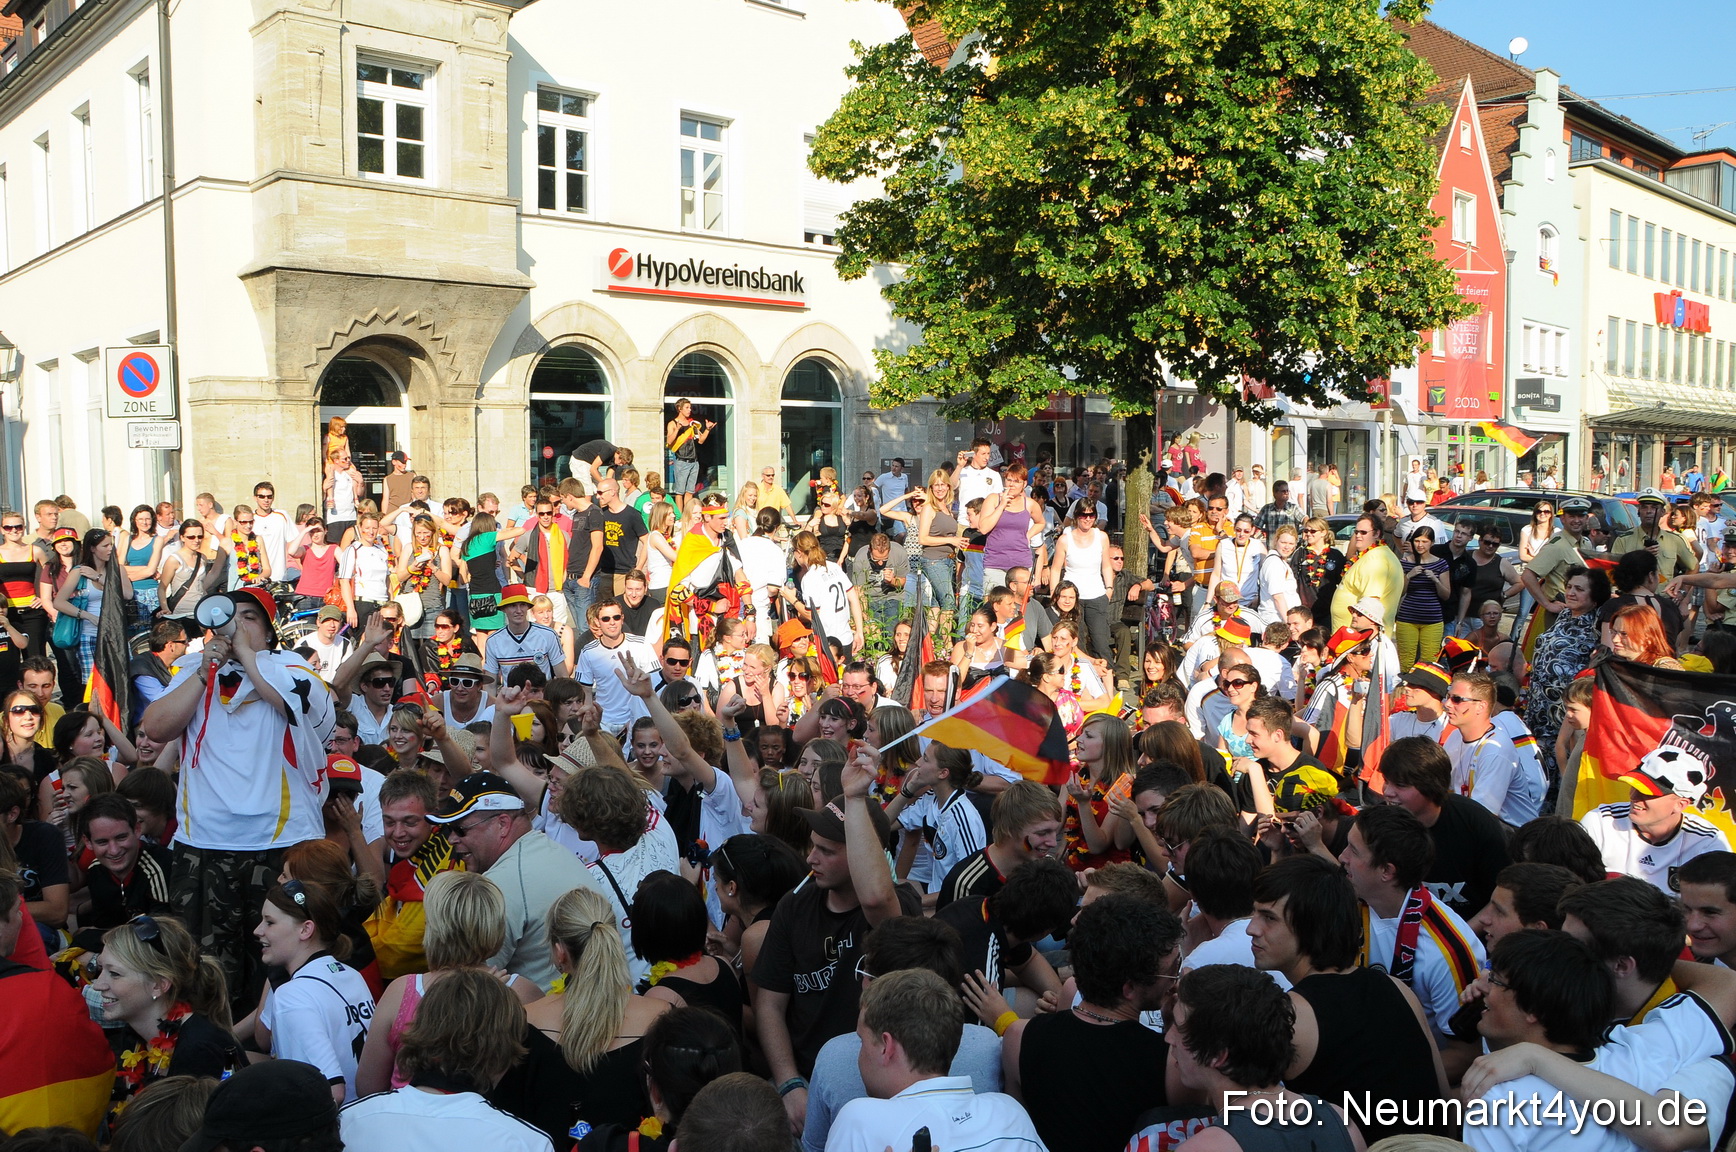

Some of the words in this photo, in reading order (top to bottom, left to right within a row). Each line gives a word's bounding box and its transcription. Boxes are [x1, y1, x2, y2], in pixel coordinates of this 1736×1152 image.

[636, 252, 805, 294] HypoVereinsbank
[1452, 333, 1478, 345] NEU
[1517, 392, 1540, 400] BONITA
[123, 401, 157, 412] ZONE
[1454, 397, 1480, 409] 2010
[828, 581, 847, 613] 21
